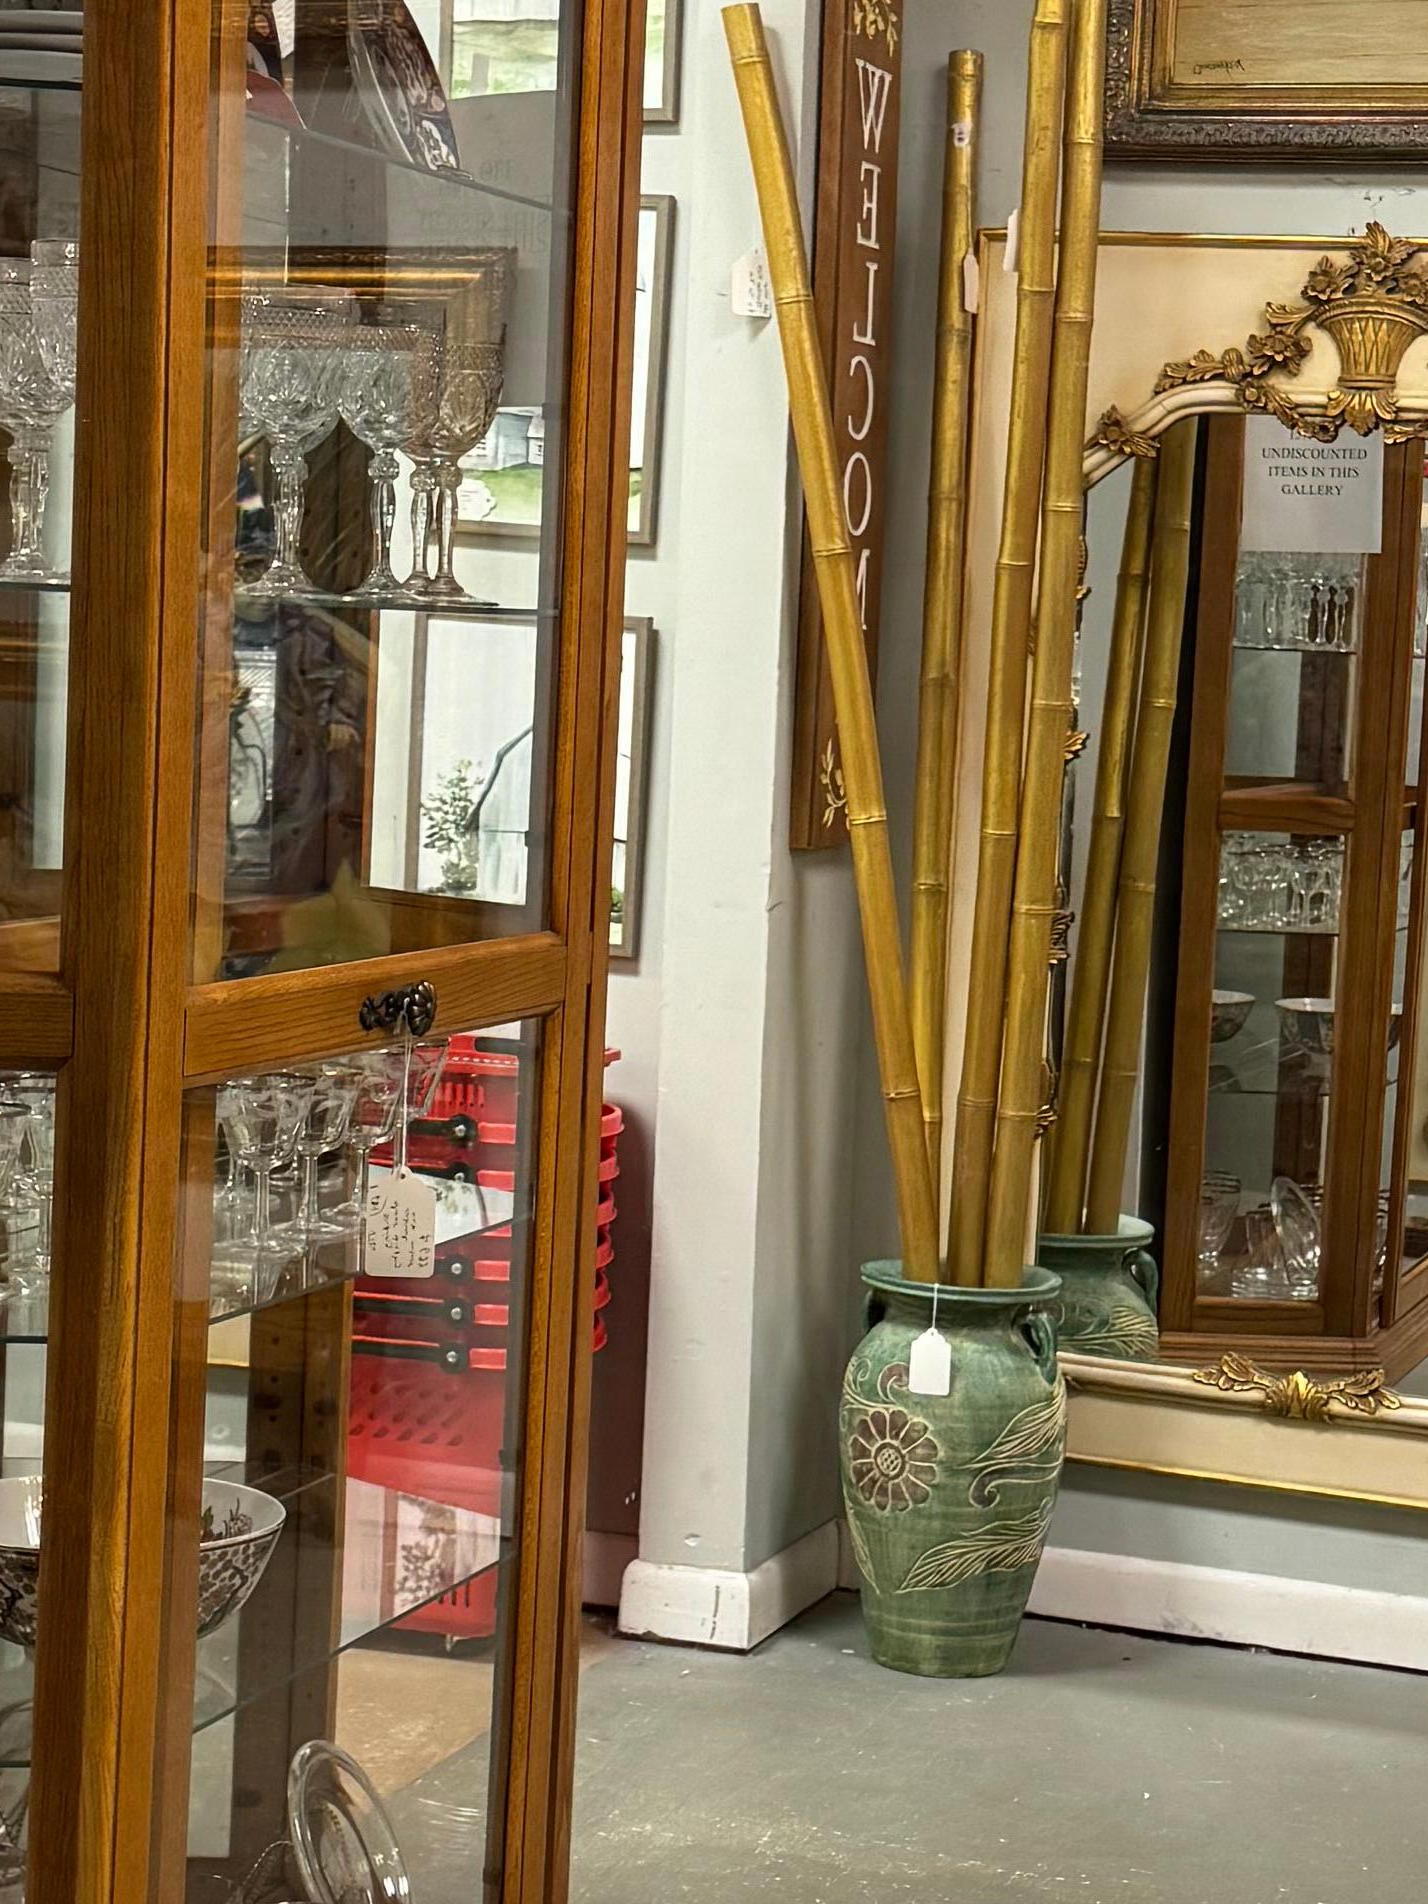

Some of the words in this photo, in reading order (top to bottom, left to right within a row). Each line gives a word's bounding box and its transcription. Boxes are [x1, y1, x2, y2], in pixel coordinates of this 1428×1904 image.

[1261, 447, 1368, 460] UNDISCOUNTED
[1268, 466, 1308, 478] ITEMS
[1311, 466, 1325, 478] IN
[1329, 466, 1360, 479] THIS
[1280, 484, 1344, 496] GALLERY
